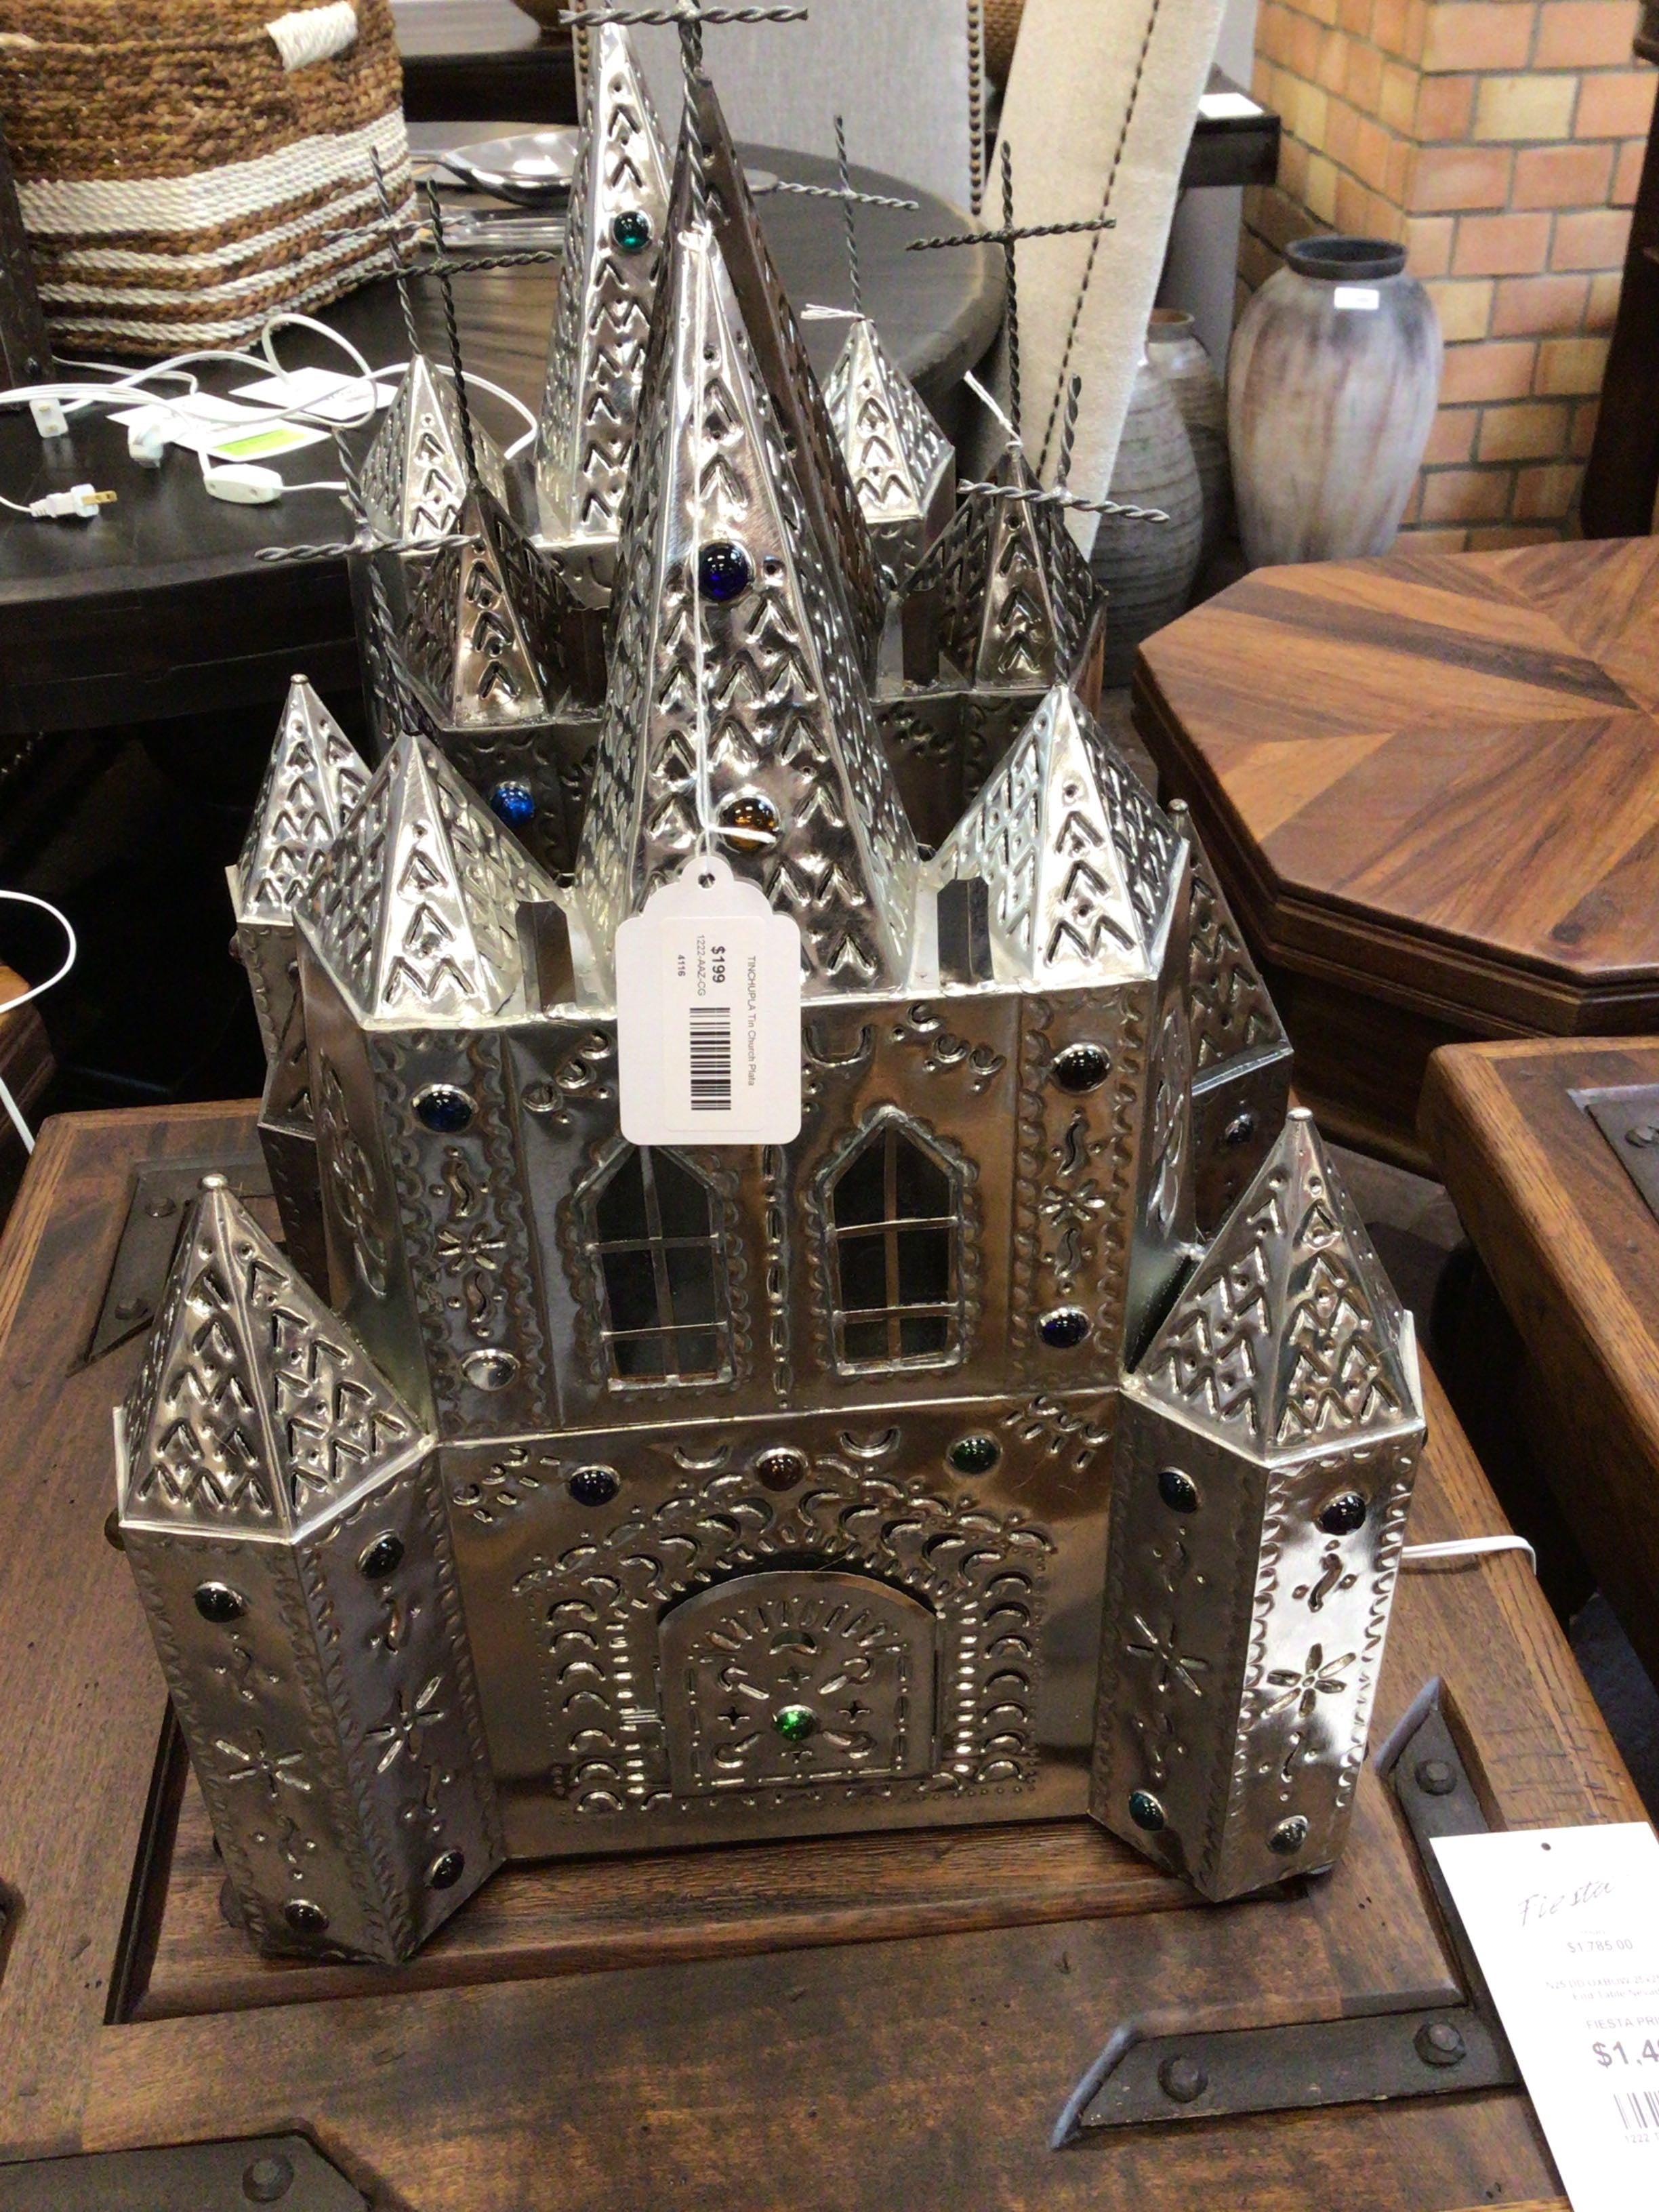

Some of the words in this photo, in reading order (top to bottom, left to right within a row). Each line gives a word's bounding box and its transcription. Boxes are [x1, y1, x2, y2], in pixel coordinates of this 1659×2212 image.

[678, 954, 686, 977] 4116
[697, 935, 706, 996] 1222-AAZ-CG
[711, 945, 726, 983] $199
[747, 956, 756, 1010] TINCHUPLA
[747, 1013, 756, 1027] Tin
[747, 1031, 756, 1061] Church
[747, 1064, 756, 1086] Plata
[1518, 1879, 1615, 1927] Fiesta
[1567, 1938, 1633, 1953] $178500
[1586, 2017, 1635, 2030] FIESTA
[1637, 2015, 1659, 2026] PRI
[1593, 2039, 1659, 2068] $1,4
